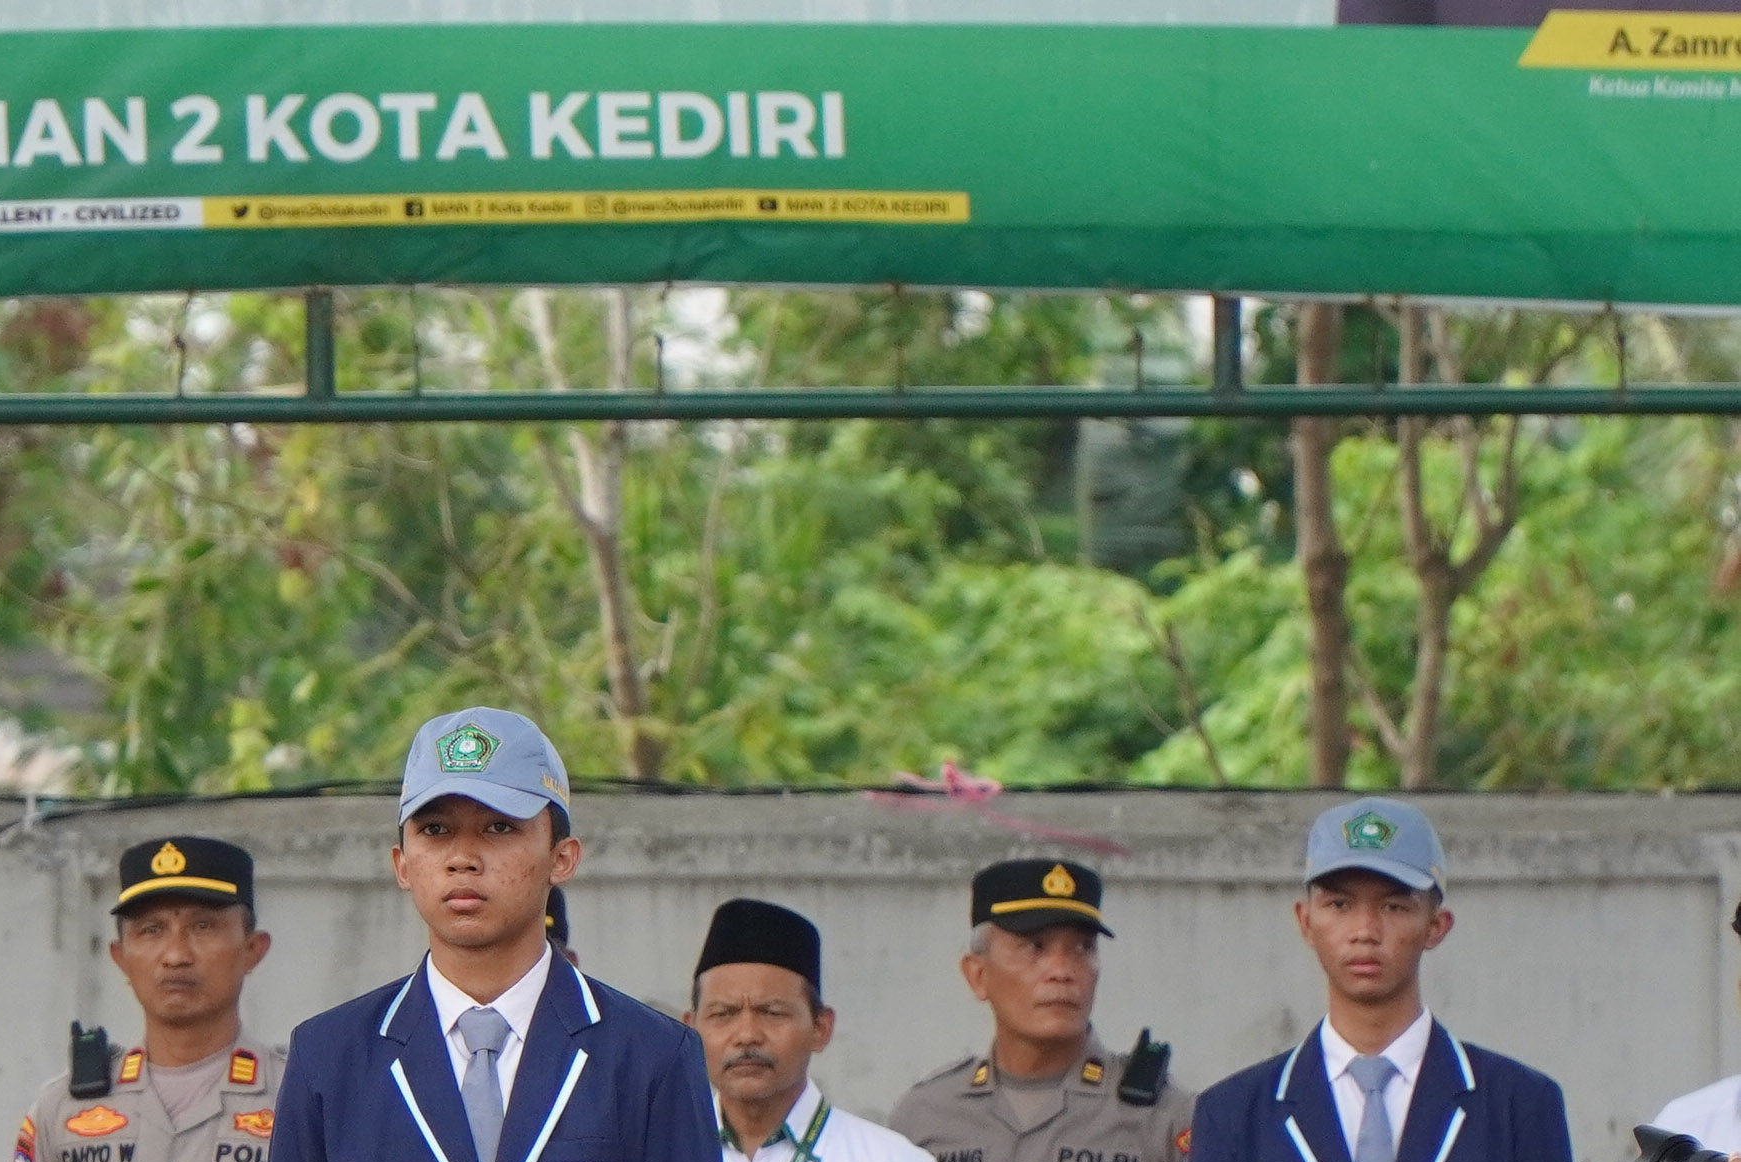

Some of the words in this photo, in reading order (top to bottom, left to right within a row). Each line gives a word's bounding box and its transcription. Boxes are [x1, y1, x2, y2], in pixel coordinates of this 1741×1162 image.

[1608, 25, 1641, 57] A.
[170, 95, 223, 164] 2
[245, 92, 508, 163] KOTA
[528, 91, 846, 160] KEDIRI
[75, 203, 181, 222] CIVILIZED
[119, 1142, 136, 1162] W
